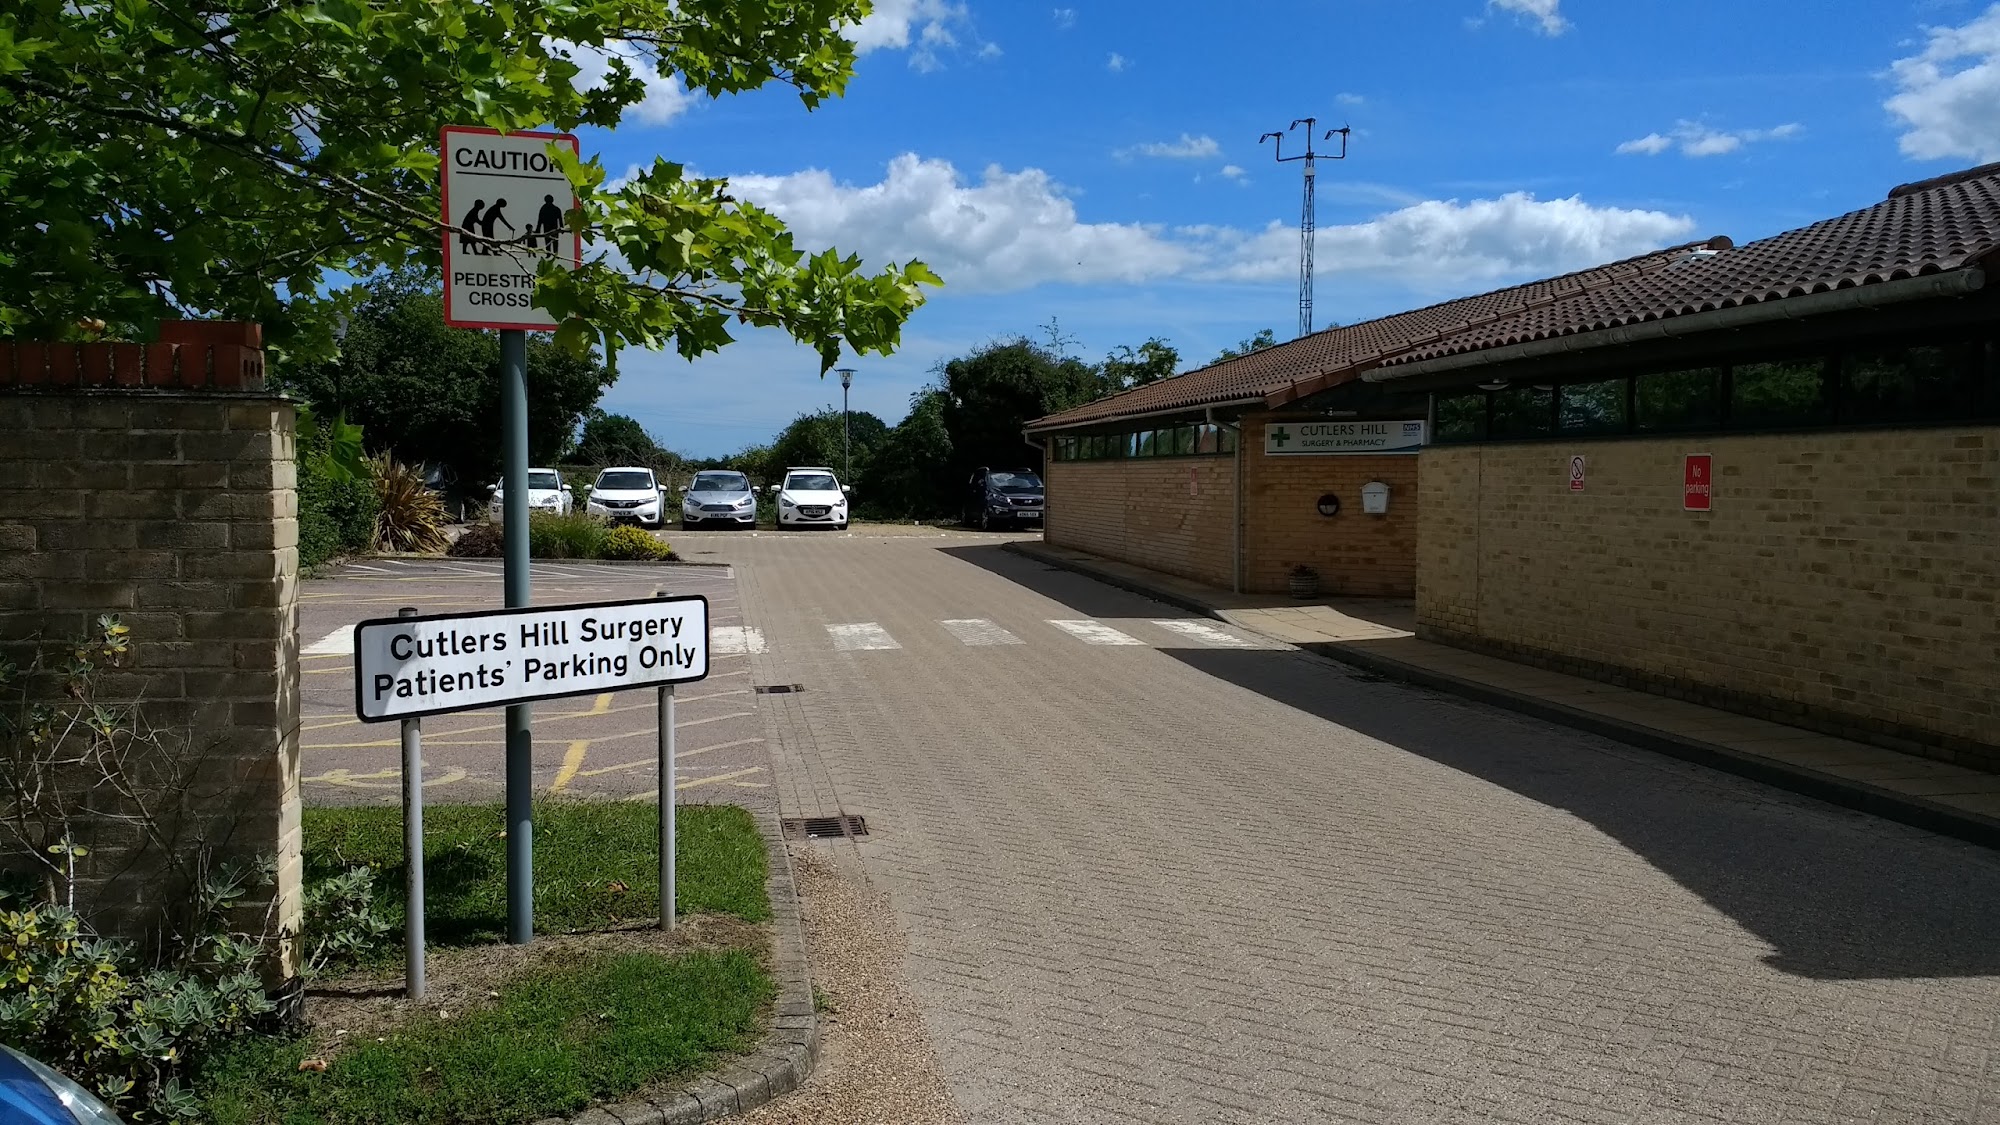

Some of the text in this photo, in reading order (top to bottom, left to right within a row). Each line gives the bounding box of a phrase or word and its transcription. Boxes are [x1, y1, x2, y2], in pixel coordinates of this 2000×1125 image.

[1301, 424, 1388, 436] CUTLERS HILL
[1343, 438, 1386, 446] PHARMACY
[1692, 465, 1702, 478] No
[1686, 482, 1709, 497] parking
[390, 616, 684, 661] Cutlers Hill Surgery
[524, 653, 628, 683] Parking
[639, 646, 696, 670] Only
